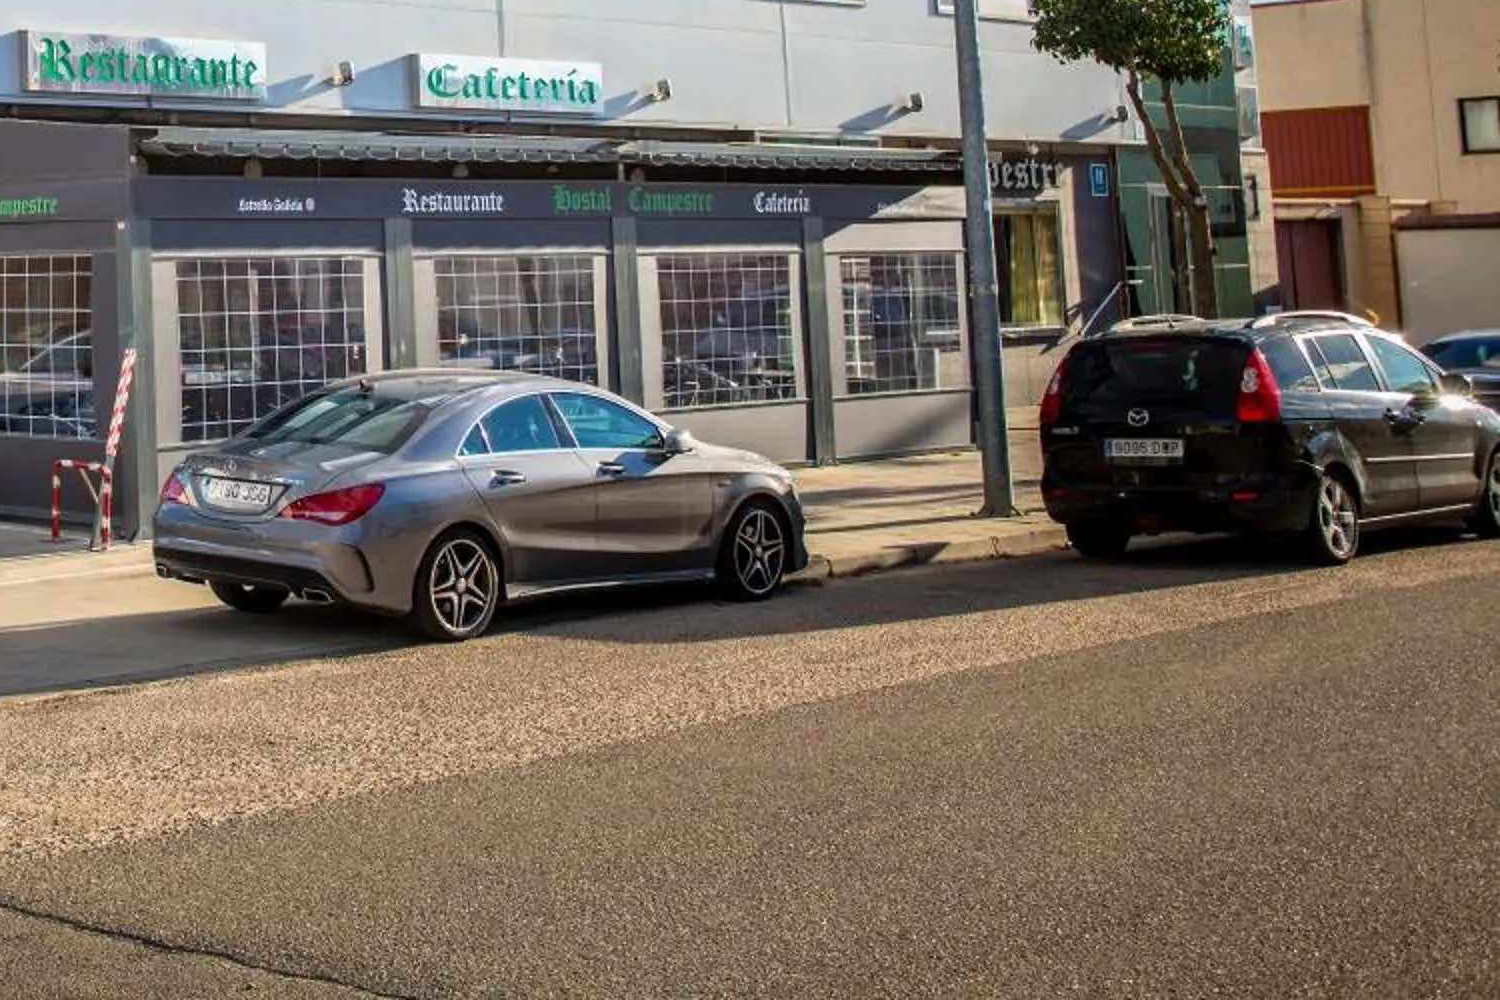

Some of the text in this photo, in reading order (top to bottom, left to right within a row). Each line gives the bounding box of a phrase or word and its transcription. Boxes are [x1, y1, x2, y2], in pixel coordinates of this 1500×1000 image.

[40, 37, 258, 89] Restaurante
[426, 63, 597, 105] Cafetería
[402, 187, 504, 213] Restaurante
[552, 183, 716, 216] Hostal Campestre
